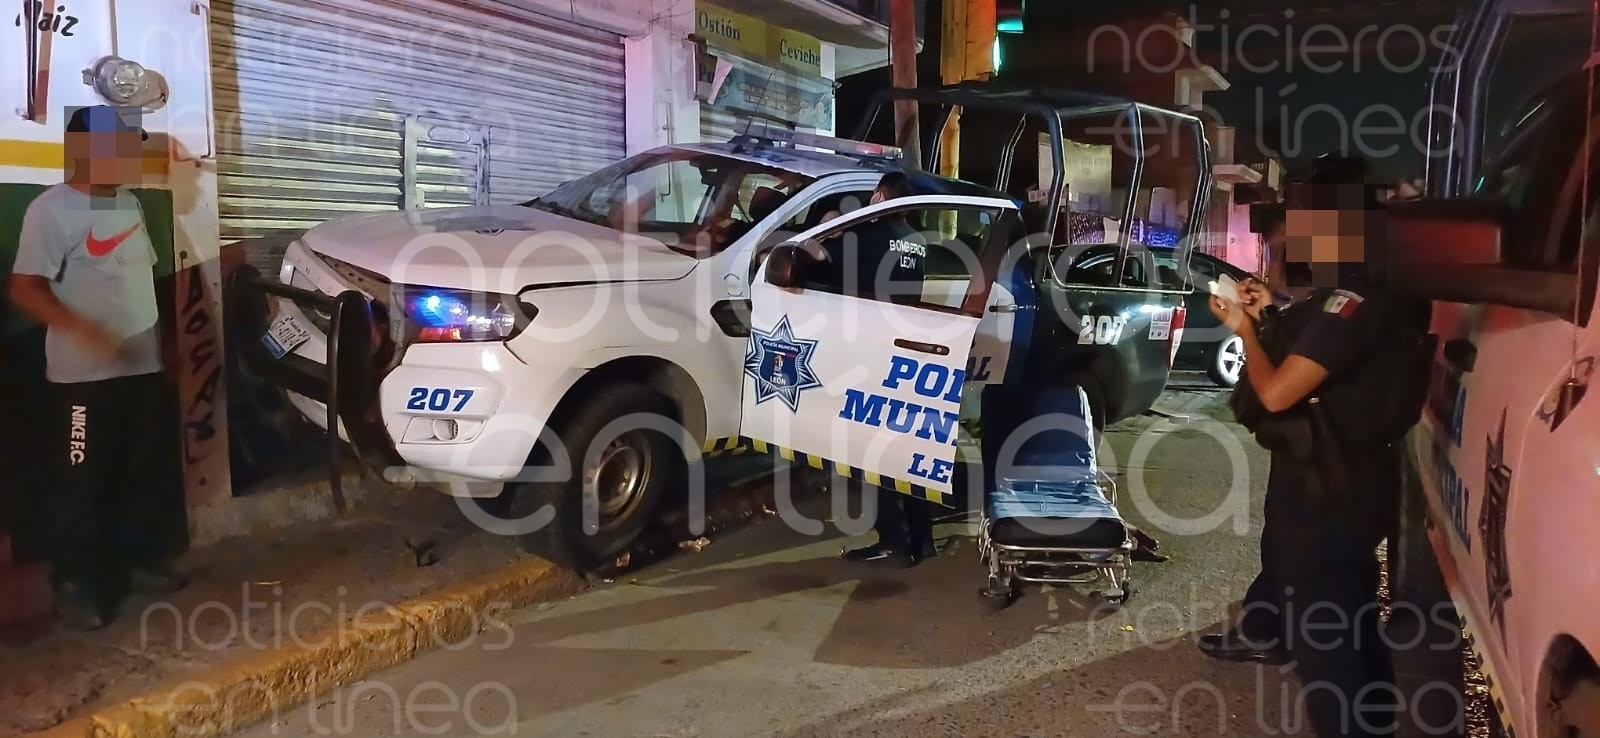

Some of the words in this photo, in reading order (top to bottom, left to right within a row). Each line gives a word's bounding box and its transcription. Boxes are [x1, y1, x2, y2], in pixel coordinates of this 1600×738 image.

[699, 12, 740, 41] Ostión
[780, 39, 821, 66] Ceviche
[889, 240, 926, 257] BOMBEROS
[1077, 314, 1127, 346] 207
[777, 343, 799, 352] MUNICIPAL
[769, 375, 787, 386] LEÓN
[407, 387, 474, 412] 207
[71, 405, 87, 440] NIKE
[839, 388, 959, 446] MUN
